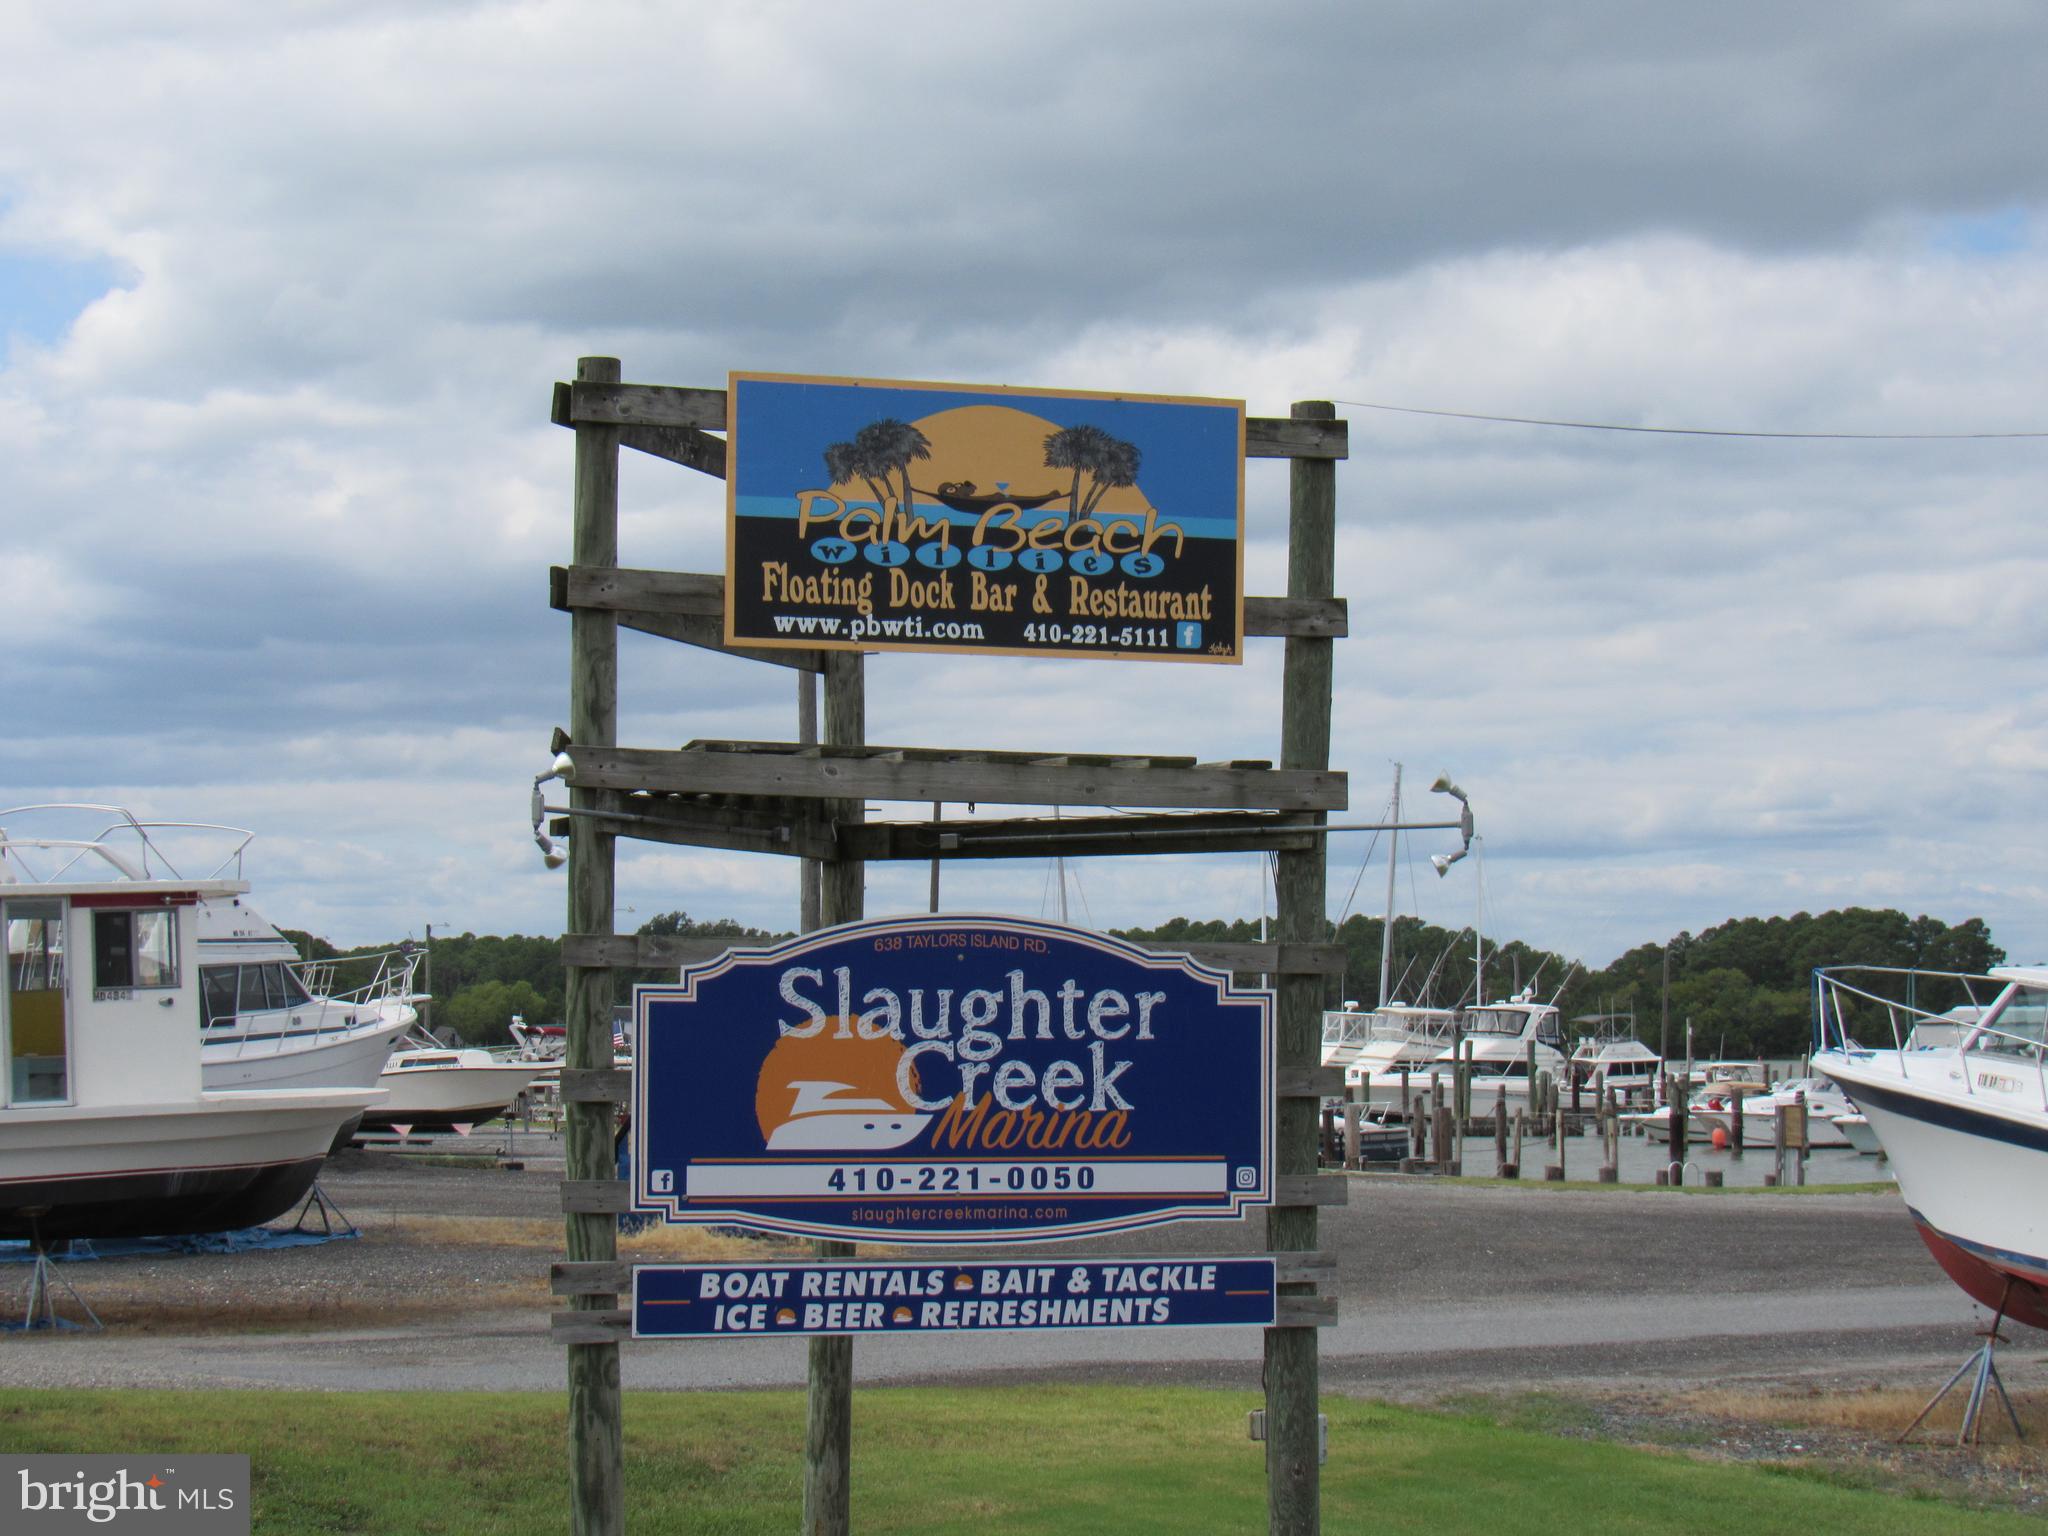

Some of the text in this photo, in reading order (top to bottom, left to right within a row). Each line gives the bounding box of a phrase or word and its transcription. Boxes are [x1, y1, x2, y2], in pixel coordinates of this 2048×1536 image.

[794, 489, 1185, 559] Palm Beach
[822, 544, 1153, 574] willies
[762, 559, 1212, 621] Floating Dock Bar & Restaurant
[774, 614, 985, 641] www.pbwti.com
[1023, 623, 1169, 648] 410-221-5111
[874, 934, 1051, 954] 638 TAYLORS ISLAND RD.
[778, 965, 1167, 1061] Slaughter
[897, 1041, 1136, 1112] Creek
[931, 1091, 1132, 1150] Marina
[828, 1167, 1096, 1191] 410-221-0050
[852, 1206, 1068, 1223] slaughtercreekmarina.com
[700, 1266, 1217, 1298] BOAT RENTALS BAIT & TACKLE
[714, 1298, 1170, 1330] ICE BEER REFRESHMENTS
